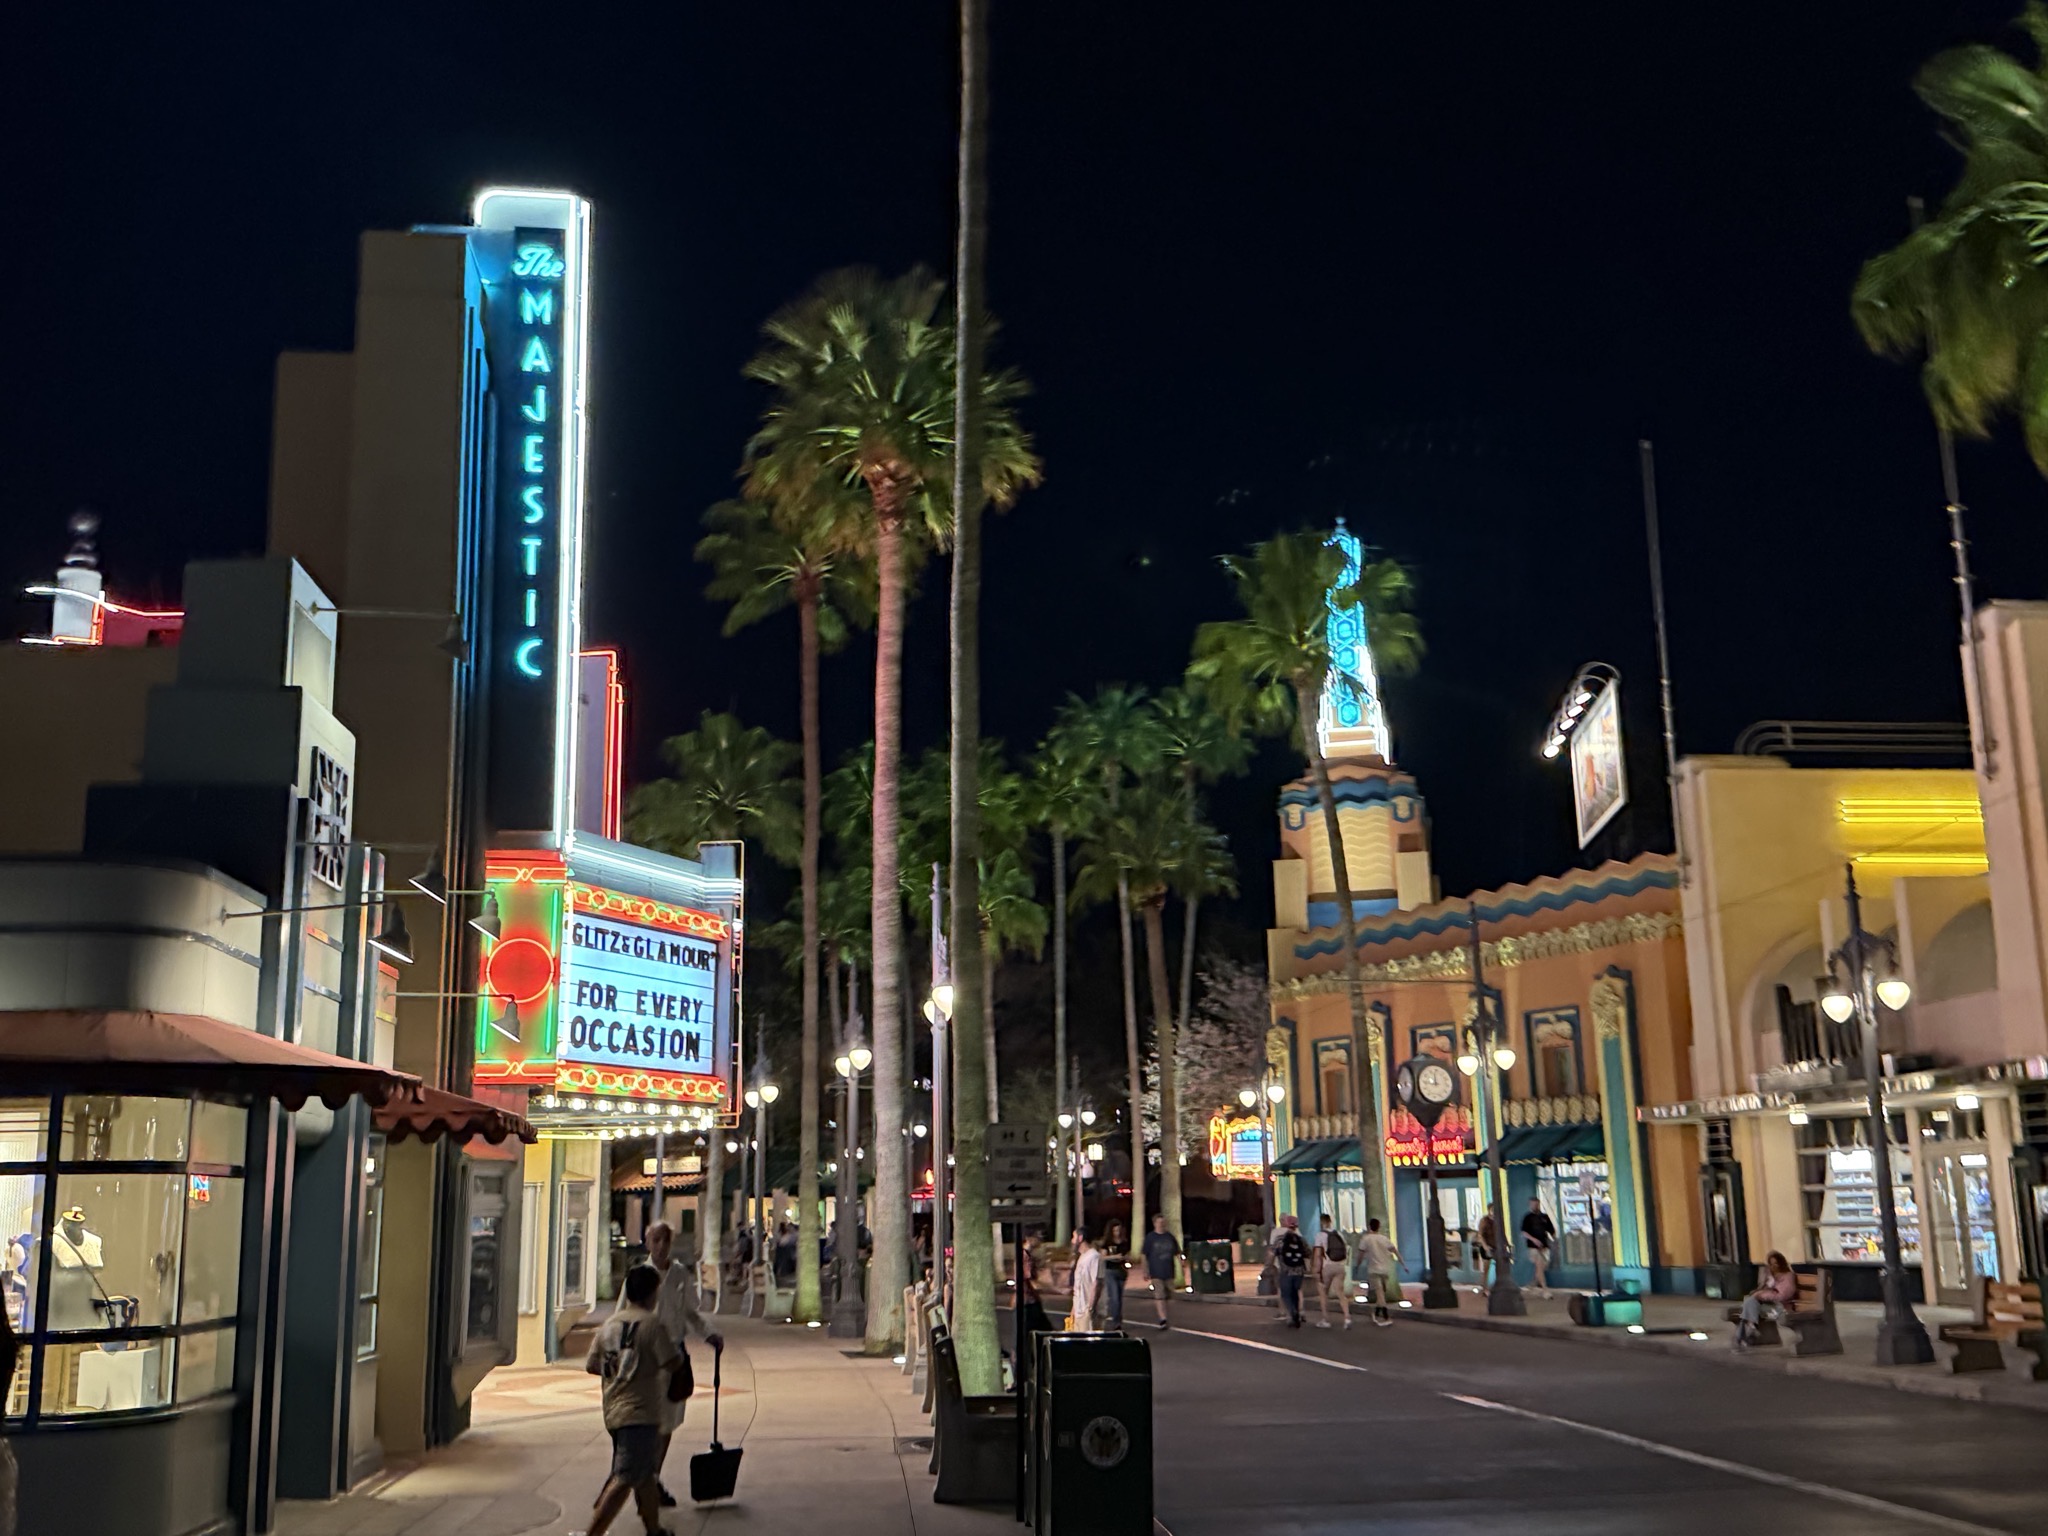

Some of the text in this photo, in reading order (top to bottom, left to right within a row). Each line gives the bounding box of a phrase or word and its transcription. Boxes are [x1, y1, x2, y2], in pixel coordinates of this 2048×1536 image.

[512, 242, 565, 278] The
[514, 290, 553, 677] MAJESTIC
[576, 980, 703, 1024] FOR EVERY
[570, 1015, 701, 1063] OCCASION
